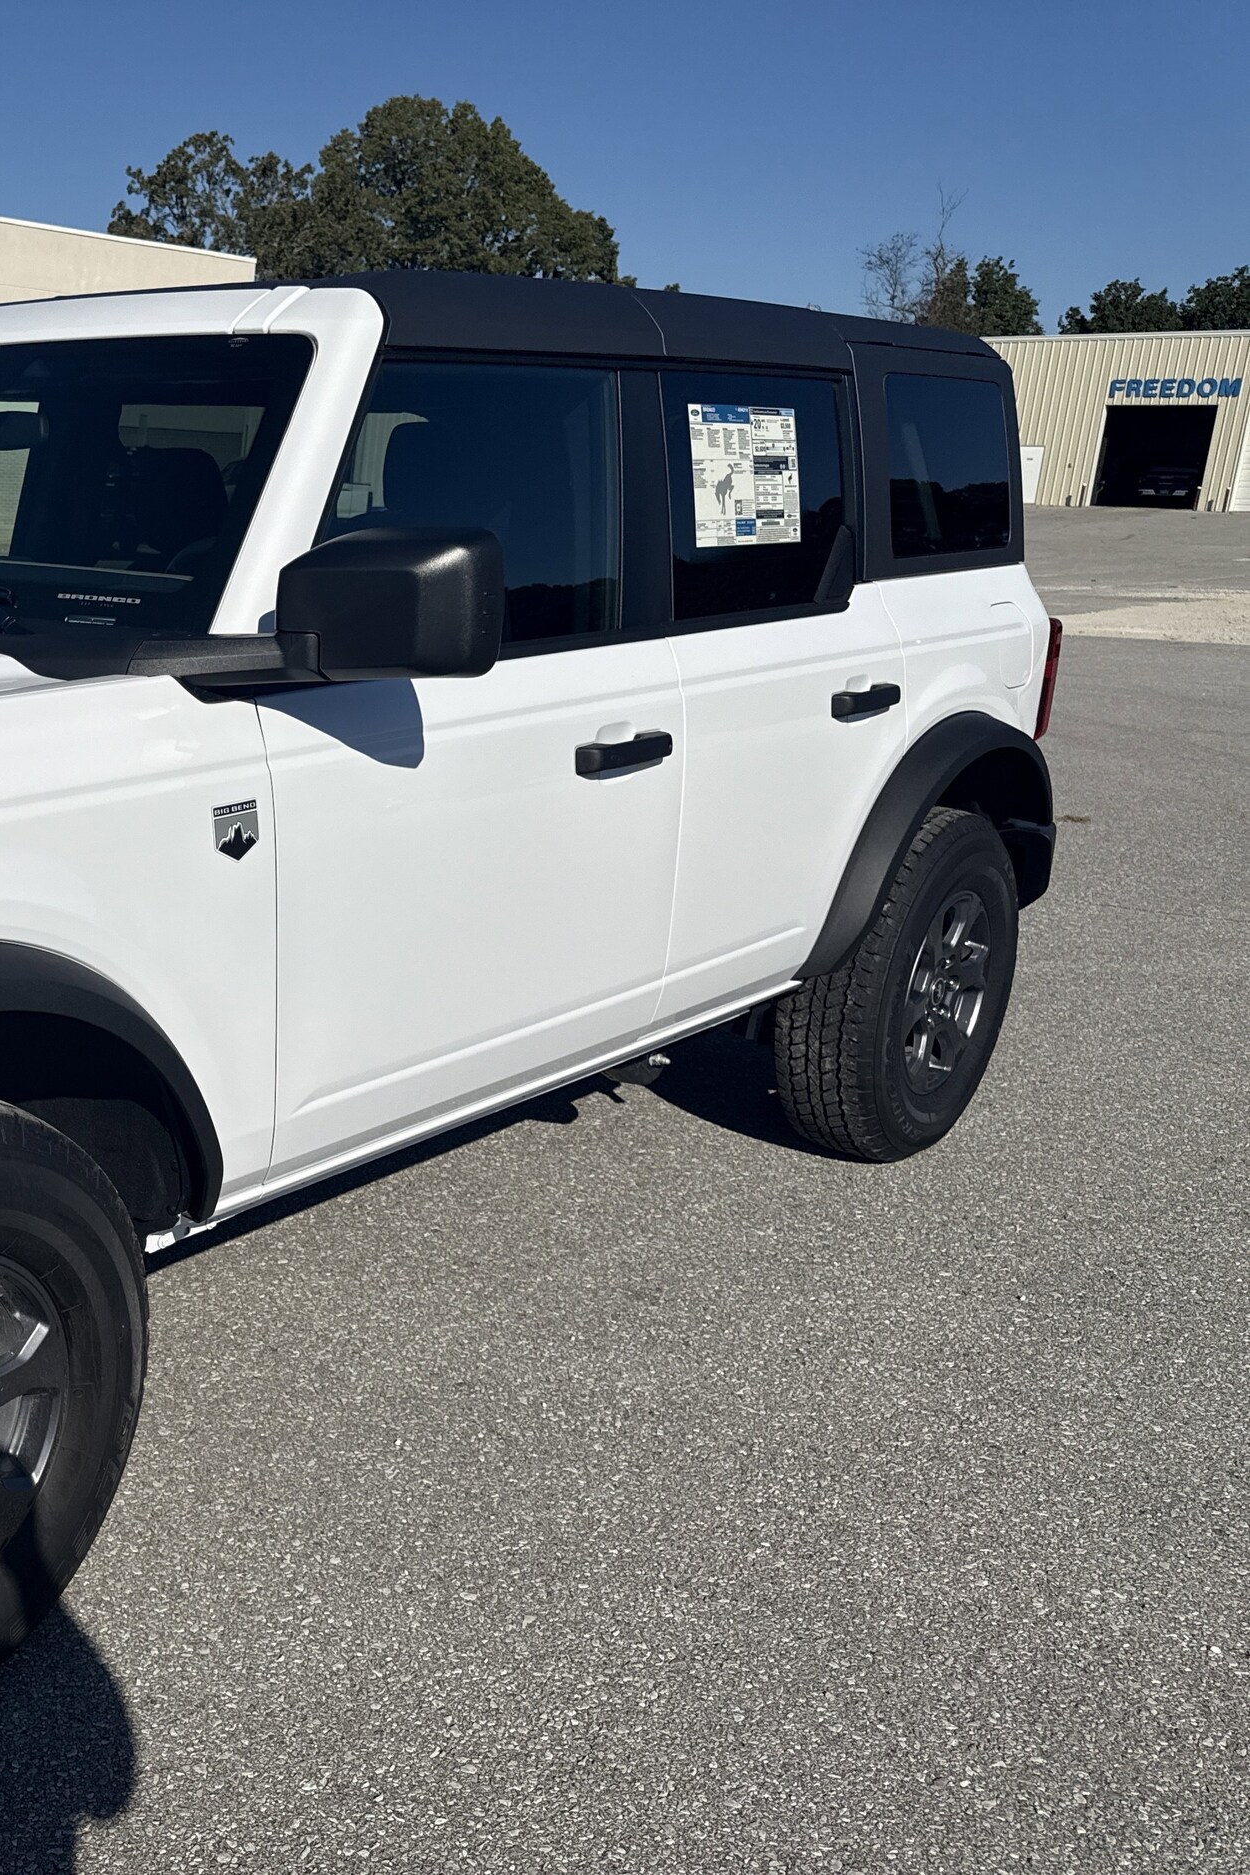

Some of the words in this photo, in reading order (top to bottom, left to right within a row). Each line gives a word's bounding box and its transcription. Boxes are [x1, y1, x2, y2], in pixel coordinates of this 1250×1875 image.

[1108, 377, 1243, 399] FREEDOM
[57, 593, 141, 605] BRONCO
[214, 807, 230, 816] BIG
[231, 802, 256, 812] BEND
